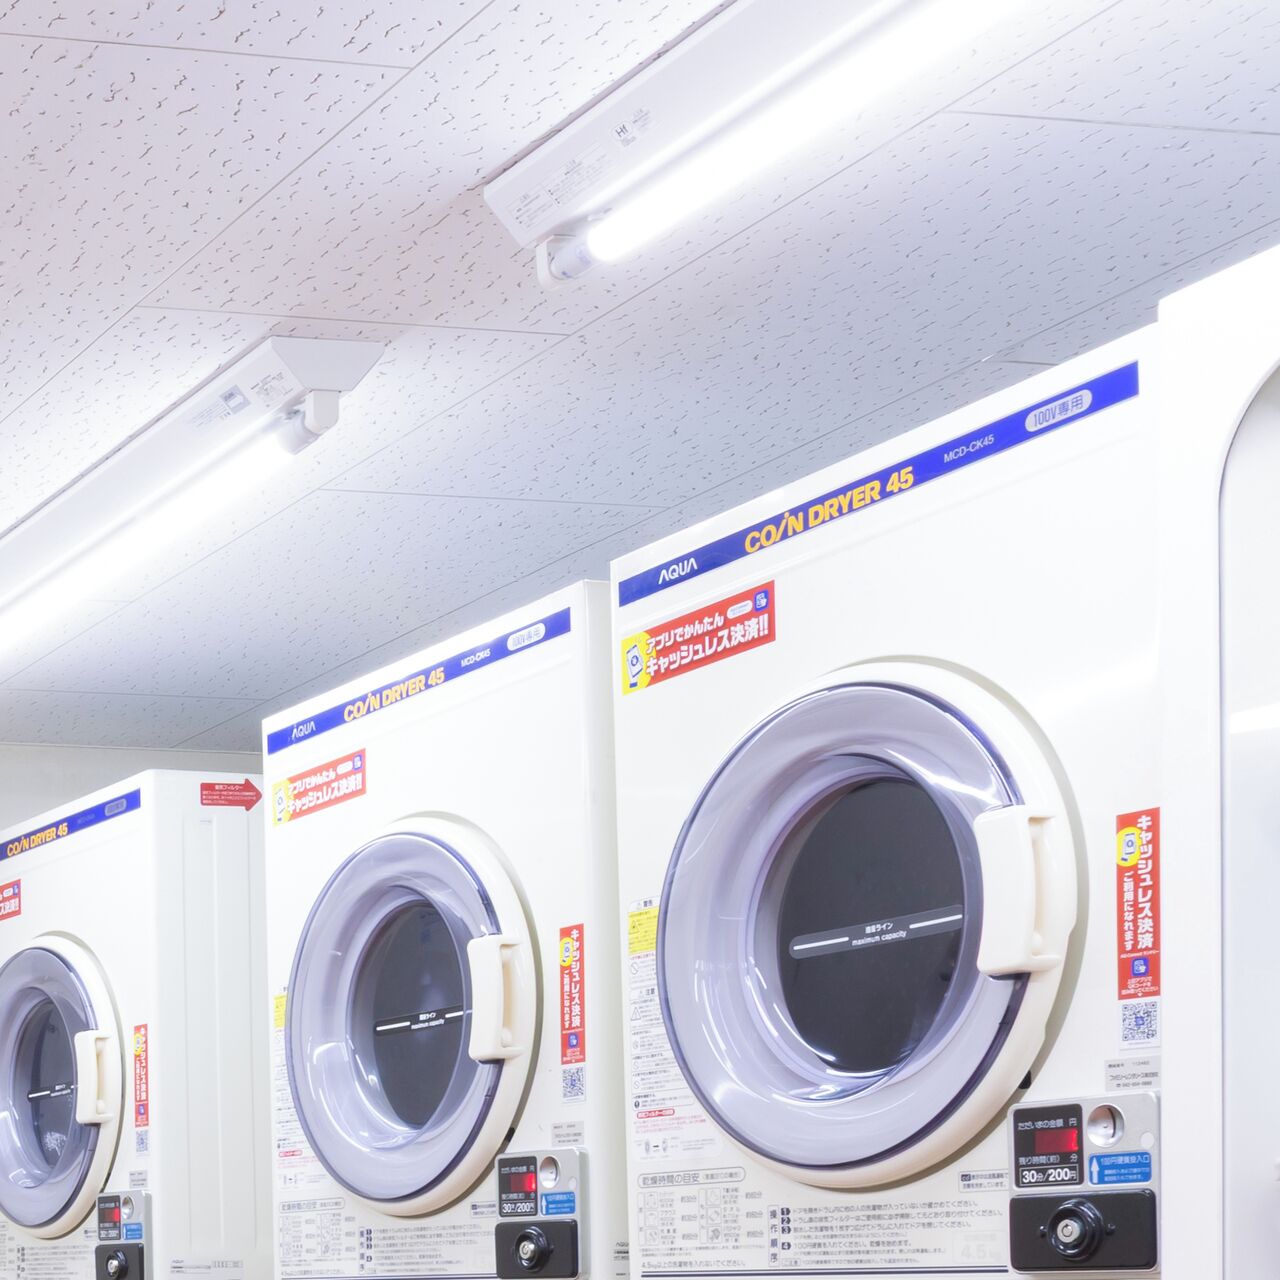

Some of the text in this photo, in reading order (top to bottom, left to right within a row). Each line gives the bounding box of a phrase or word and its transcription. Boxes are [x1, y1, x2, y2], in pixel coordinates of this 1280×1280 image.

[1032, 394, 1085, 428] 100V専用
[943, 433, 995, 464] MCD-CK45
[807, 482, 880, 528] DRYER
[885, 465, 915, 493] 45
[657, 556, 698, 585] AQUA
[646, 612, 724, 655] アプリでかんたん
[382, 673, 426, 707] DRYER
[427, 666, 445, 687] 45
[291, 720, 316, 741] AQUA
[30, 827, 57, 850] DRYER
[57, 822, 69, 840] 45
[1137, 814, 1153, 950] キャッシュレス決済
[1123, 871, 1135, 951] ご利用になれます
[851, 930, 908, 946] maximum capacity
[1017, 1117, 1077, 1131] ただいまの金額 円
[1070, 1153, 1078, 1163] 分
[1022, 1168, 1077, 1183] 30分/200円
